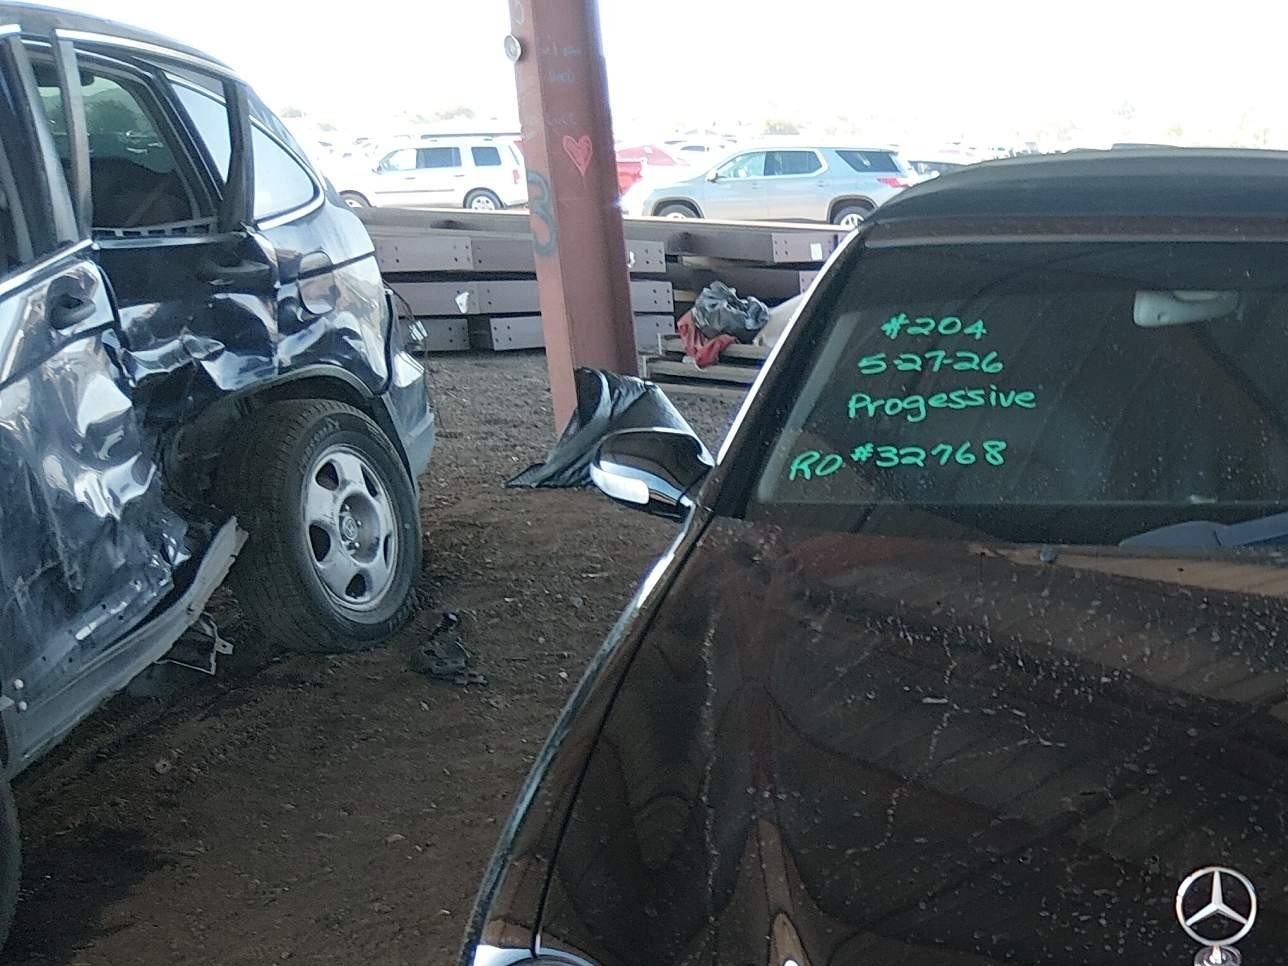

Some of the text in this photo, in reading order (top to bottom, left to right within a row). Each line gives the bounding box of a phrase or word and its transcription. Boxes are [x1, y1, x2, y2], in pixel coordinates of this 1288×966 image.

[881, 313, 987, 339] #204
[848, 384, 1036, 422] Progessive
[850, 440, 1007, 467] #32768
